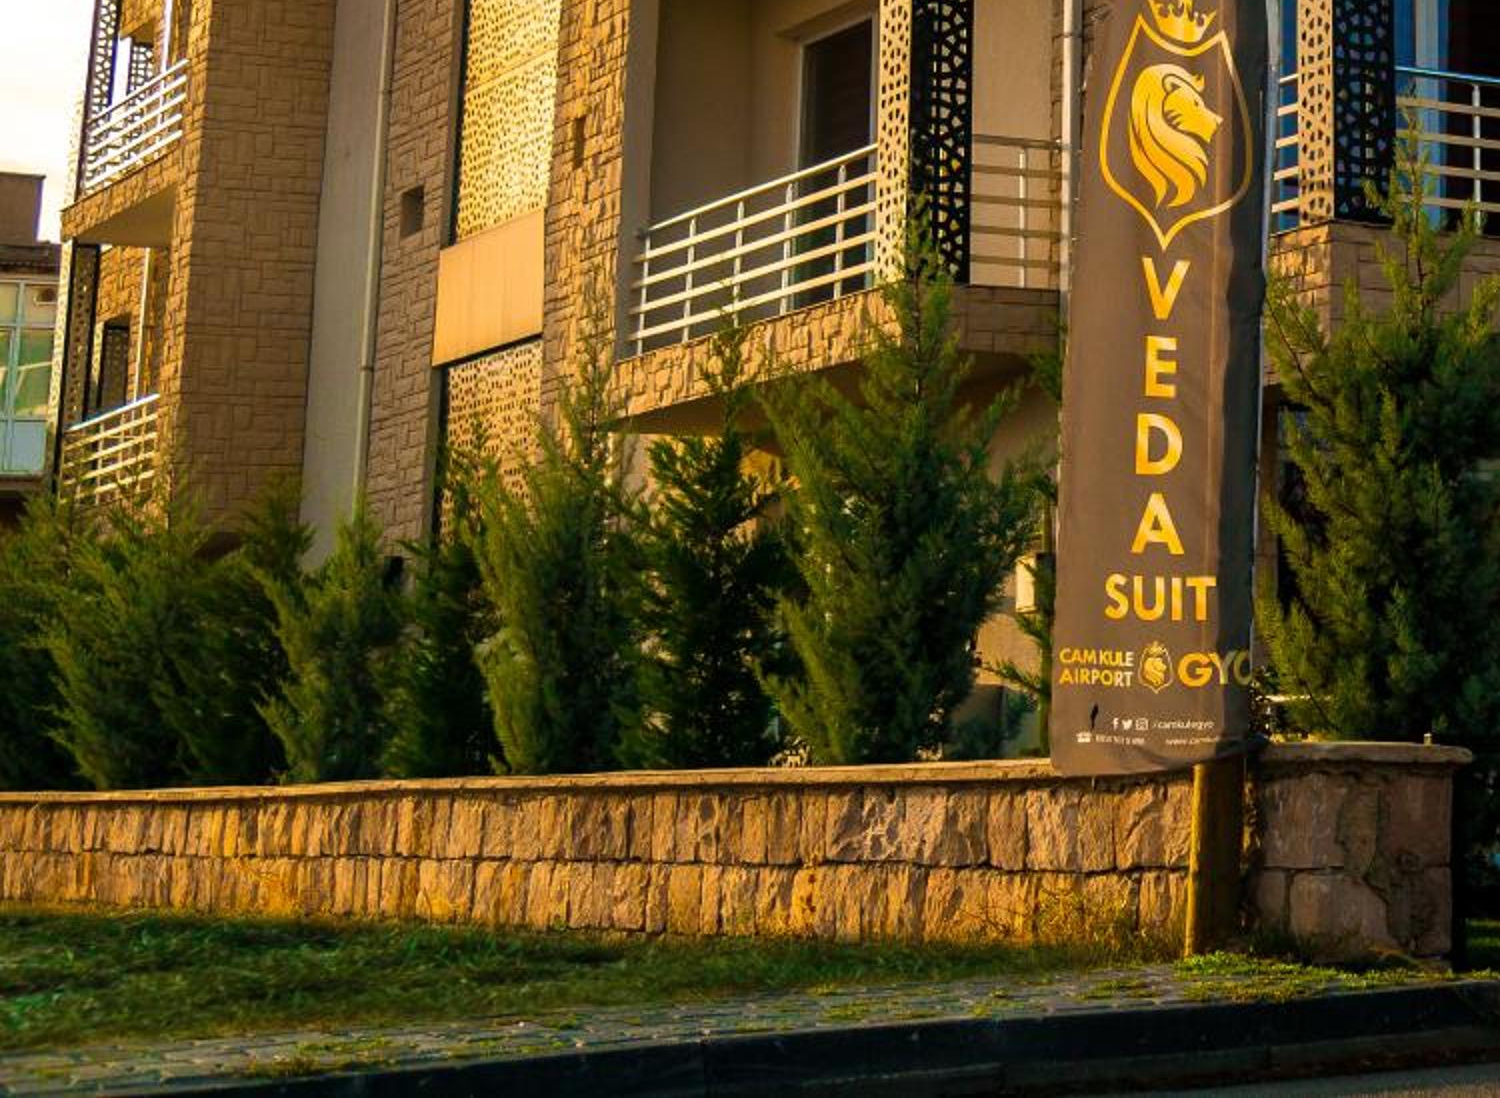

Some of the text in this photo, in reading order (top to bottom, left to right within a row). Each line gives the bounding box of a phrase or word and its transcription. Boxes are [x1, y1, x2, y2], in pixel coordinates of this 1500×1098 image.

[1131, 256, 1191, 556] VEDA
[1104, 573, 1217, 621] SUIT
[1058, 667, 1134, 687] AIRPORT
